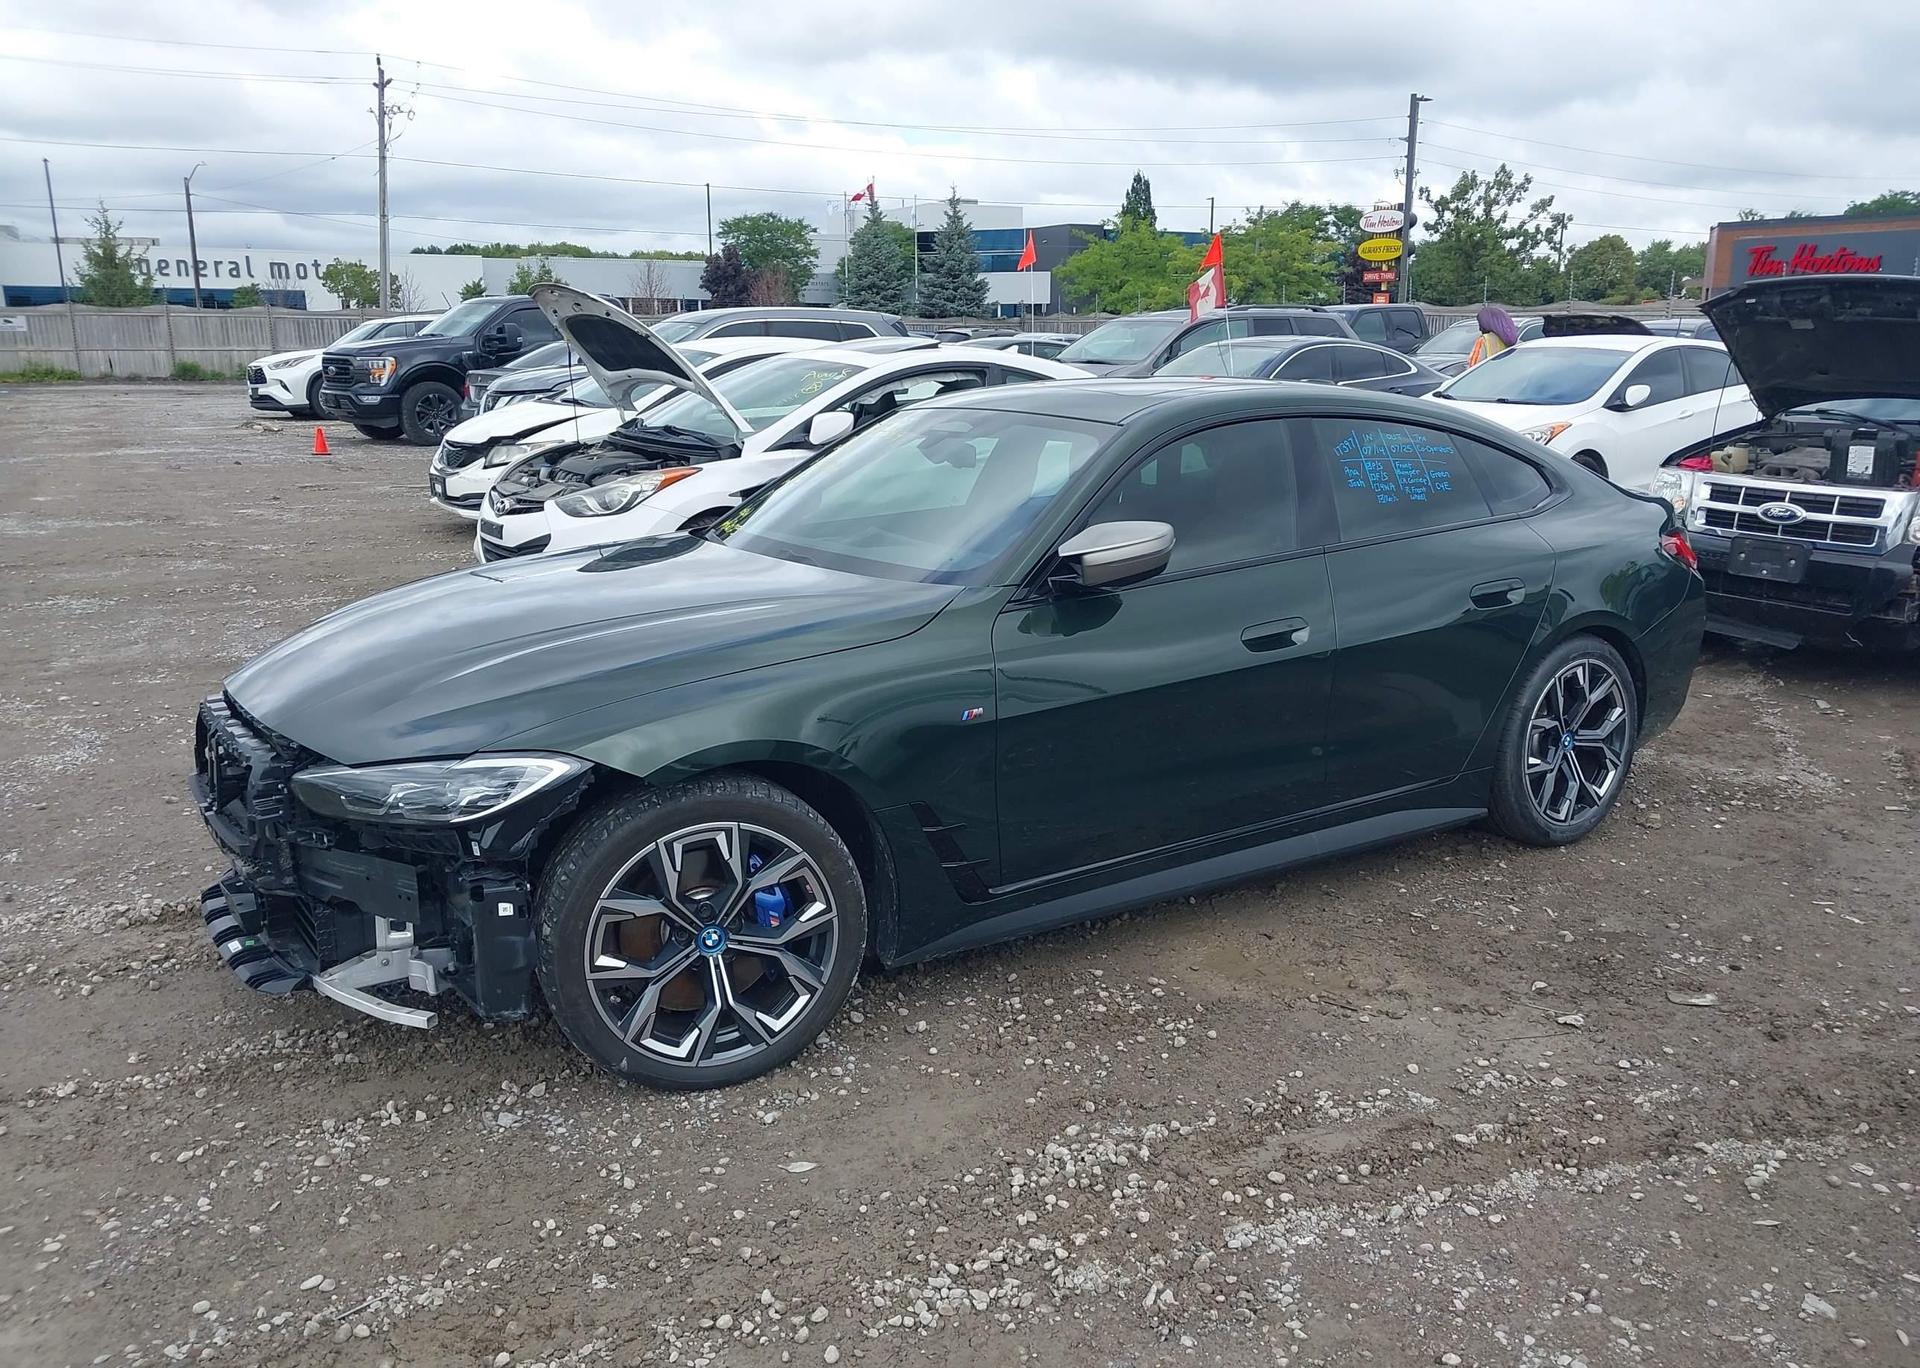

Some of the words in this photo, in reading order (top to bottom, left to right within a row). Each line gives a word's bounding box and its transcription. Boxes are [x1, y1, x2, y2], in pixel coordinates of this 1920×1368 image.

[1363, 214, 1377, 229] Tim
[1747, 246, 1785, 276] Tim
[1788, 243, 1882, 273] Hortons
[1364, 273, 1379, 281] DRIVE
[1380, 272, 1395, 280] THRU
[1767, 507, 1792, 518] Ford
